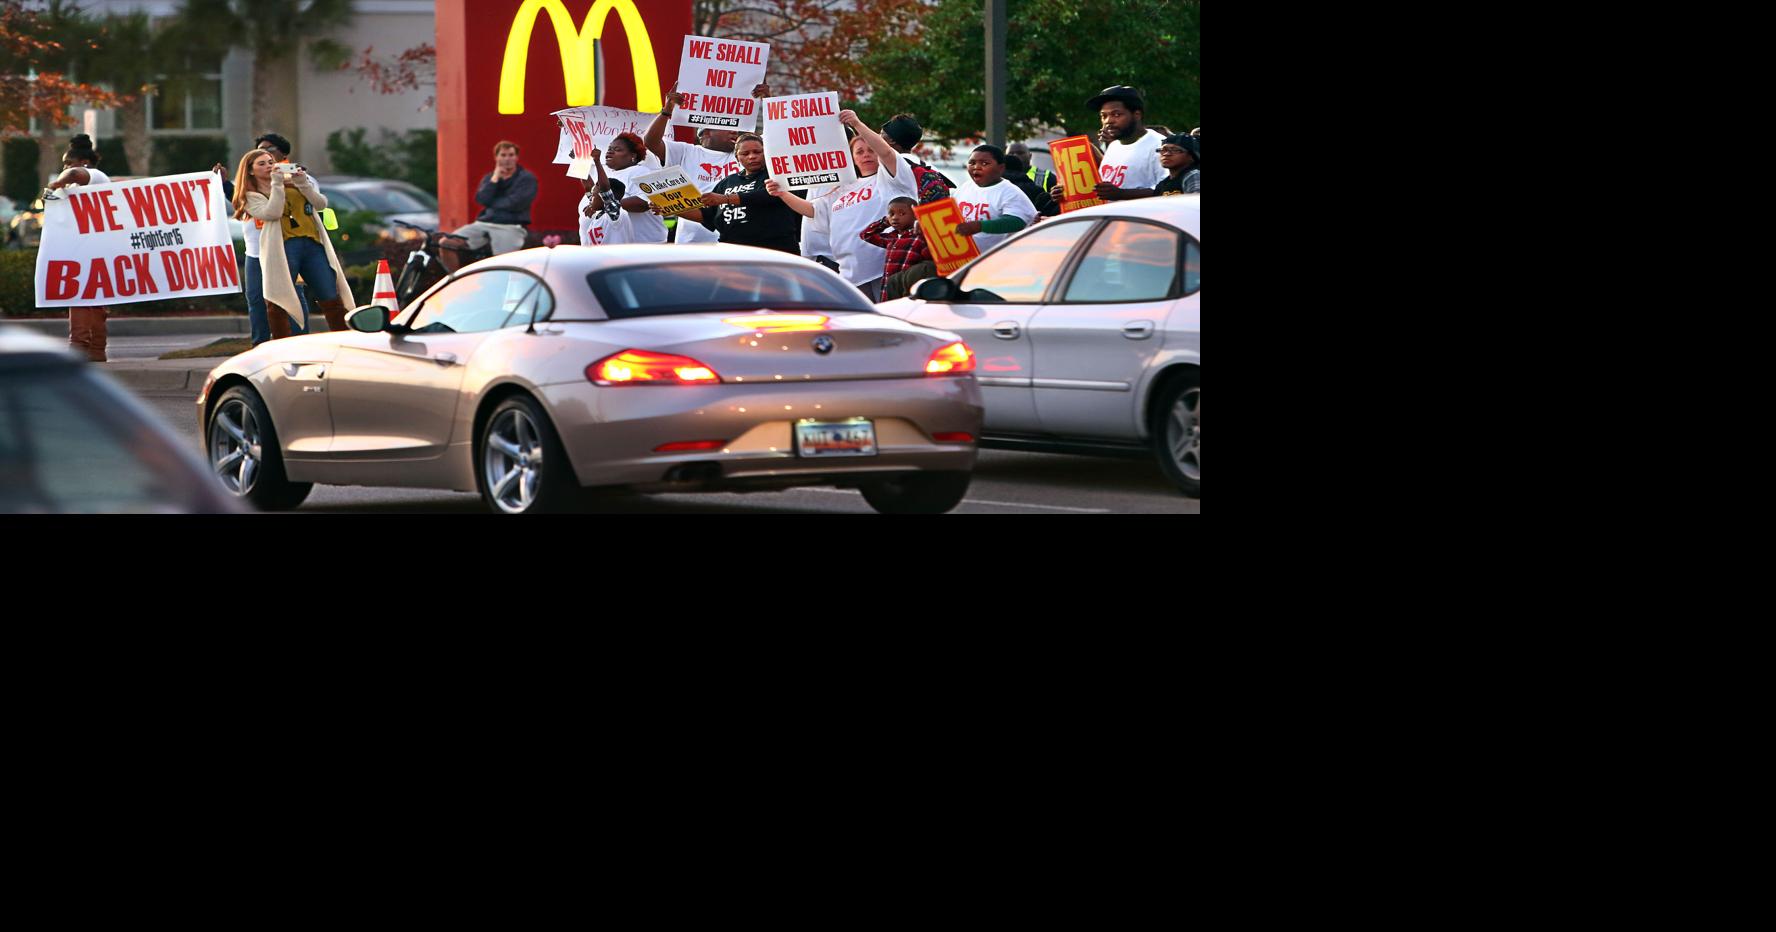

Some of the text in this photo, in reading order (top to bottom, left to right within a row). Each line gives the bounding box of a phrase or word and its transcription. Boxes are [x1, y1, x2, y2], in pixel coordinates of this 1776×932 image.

[690, 40, 761, 65] WE SHALL
[706, 68, 737, 88] NOT
[679, 92, 754, 115] BE MOVED
[767, 97, 835, 120] WE SHALL
[690, 115, 738, 126] #FightFor15
[788, 126, 817, 146] NOT
[723, 161, 740, 177] 15
[771, 150, 847, 175] BE MOVED
[651, 180, 668, 190] Take
[665, 178, 681, 187] Care
[790, 173, 837, 185] #FightFor15
[660, 190, 683, 202] Your
[69, 178, 211, 235] WE WON'T
[723, 206, 747, 225] $15
[130, 228, 184, 250] #FightFor15
[45, 244, 238, 300] BACK DOWN
